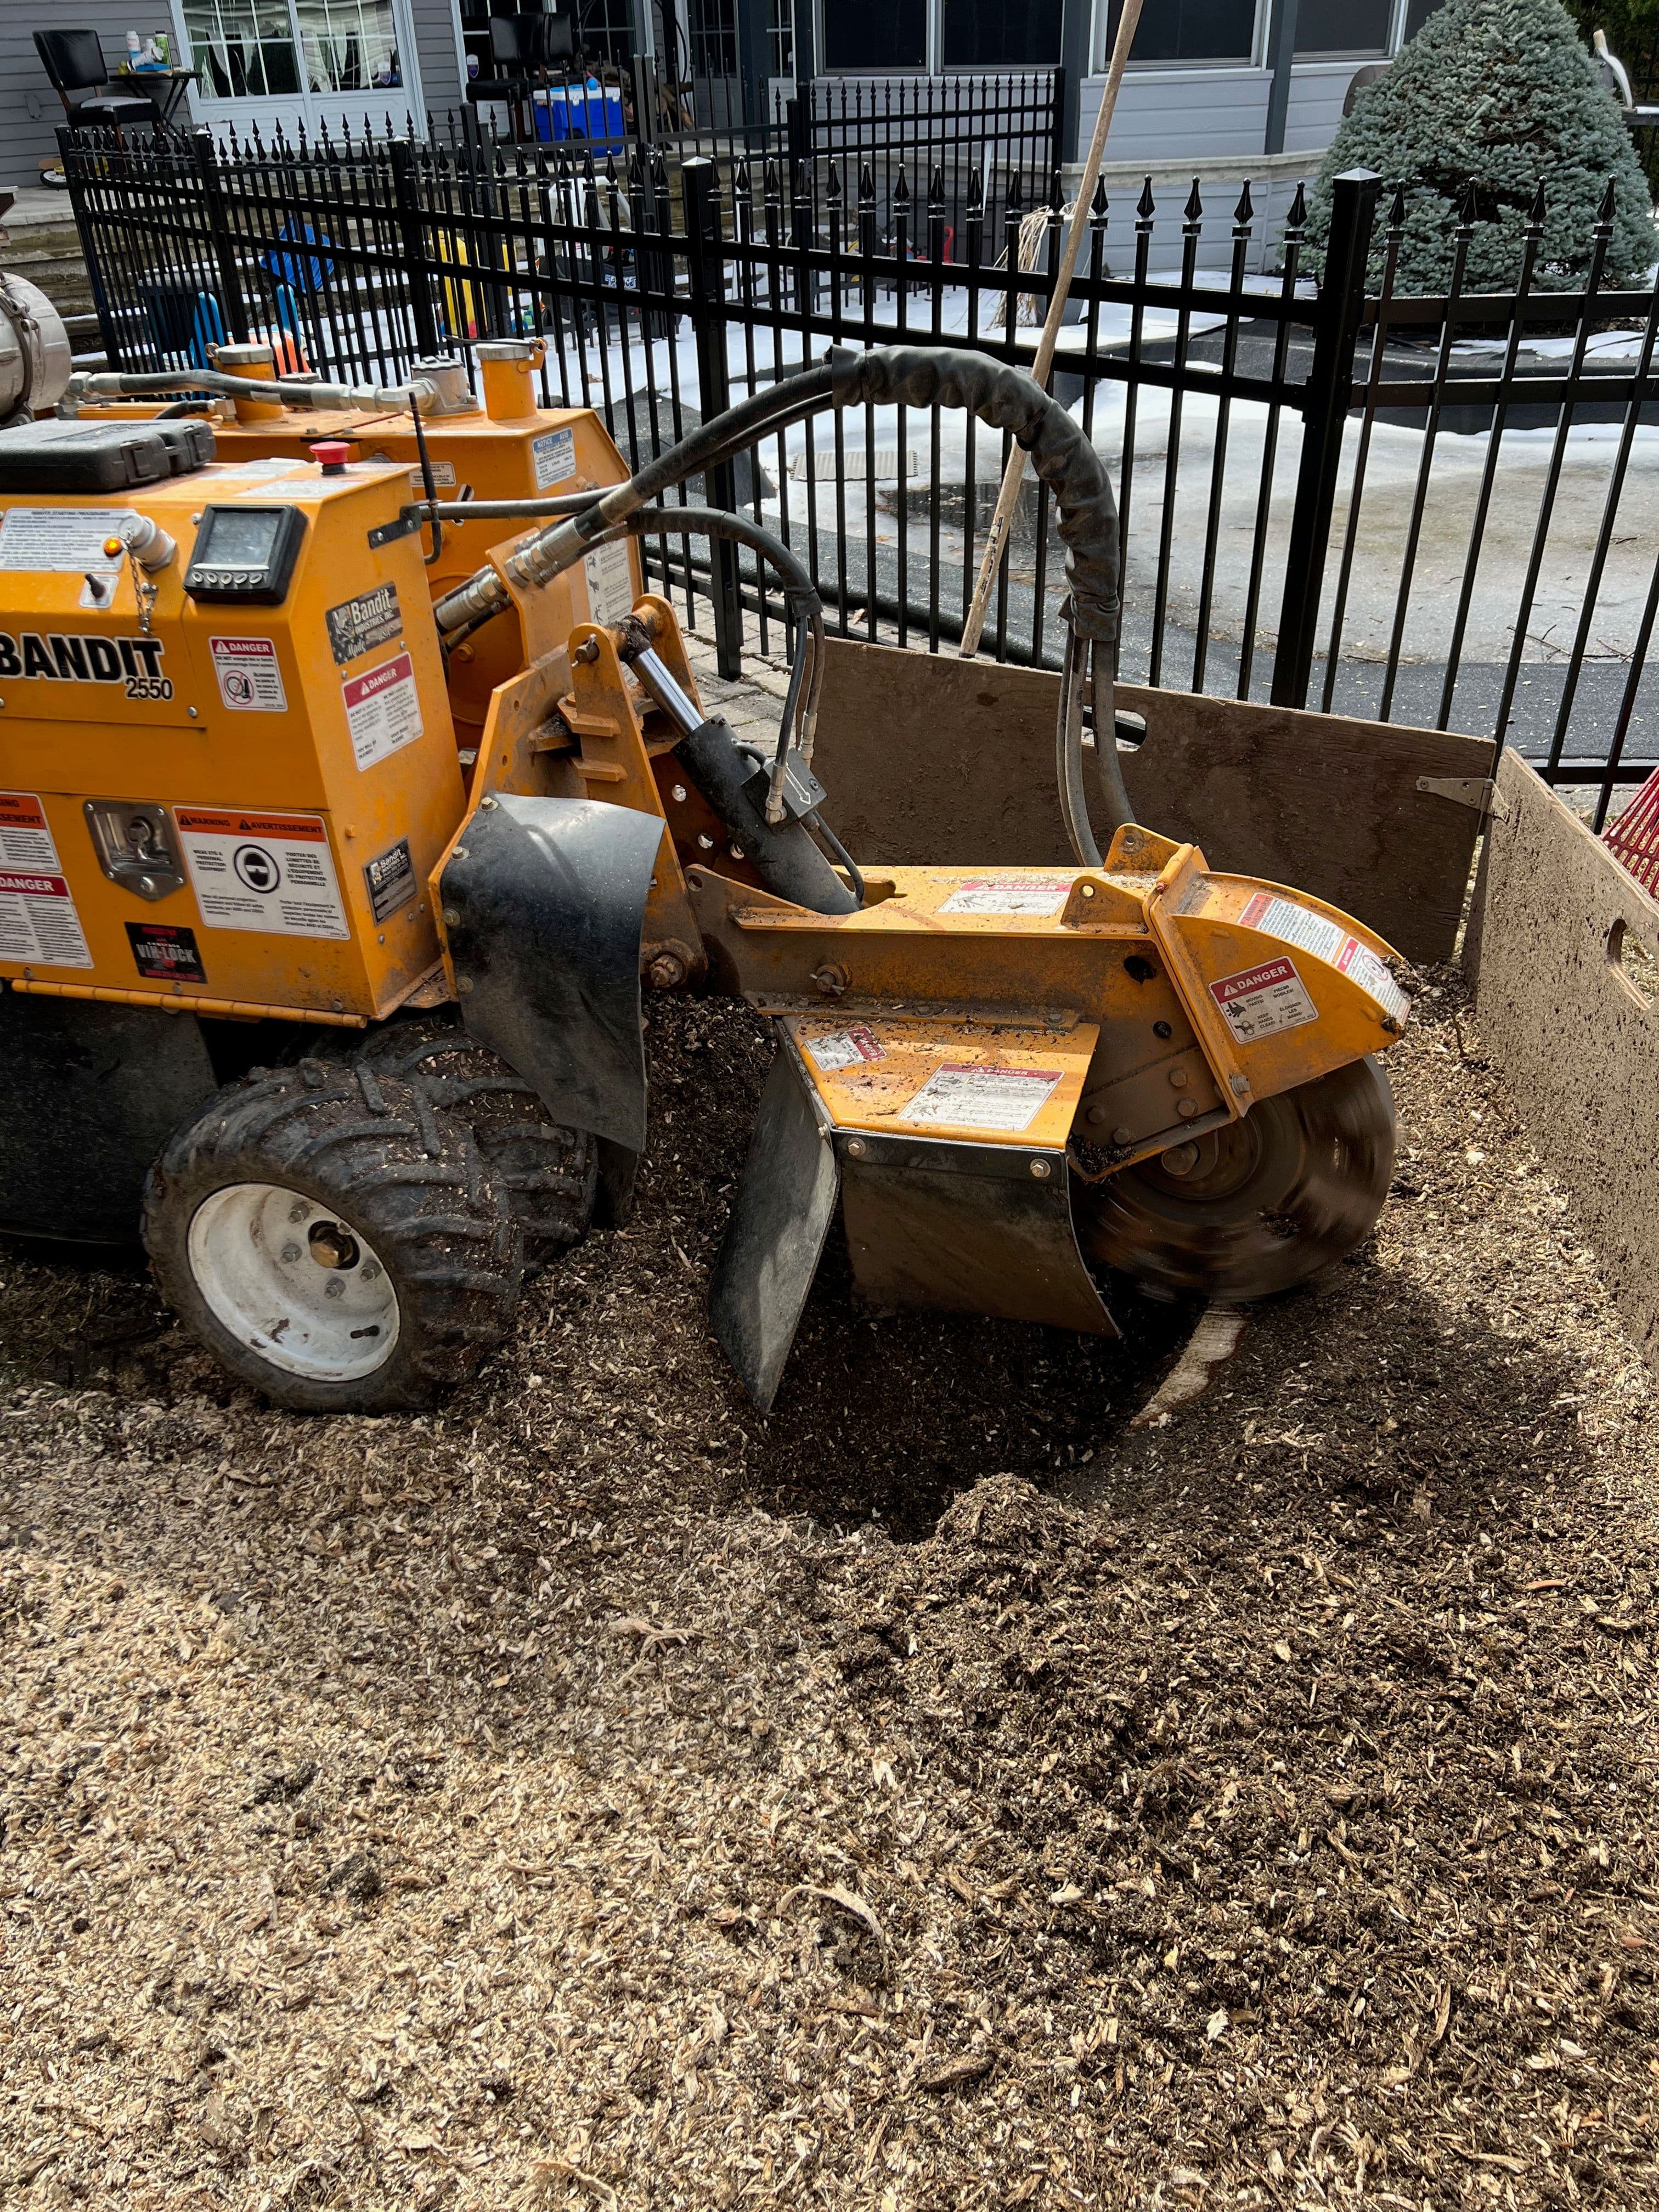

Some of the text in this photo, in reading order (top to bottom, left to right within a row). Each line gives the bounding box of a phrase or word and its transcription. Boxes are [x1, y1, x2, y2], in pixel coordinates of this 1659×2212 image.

[537, 437, 553, 448] NOTICE
[351, 589, 392, 624] Bandit
[229, 642, 270, 653] DANGER
[0, 635, 163, 680] BANDIT
[368, 668, 397, 690] DANGER
[125, 677, 173, 700] 2550
[190, 817, 323, 833] WARNING AVERTISSEMENT
[381, 848, 402, 867] Bandit
[0, 877, 54, 891] DANGER
[1237, 966, 1288, 990] DANGER
[1245, 994, 1263, 1003] MOVING
[1257, 1016, 1273, 1024] HANDS
[986, 1068, 1029, 1076] DANGER
